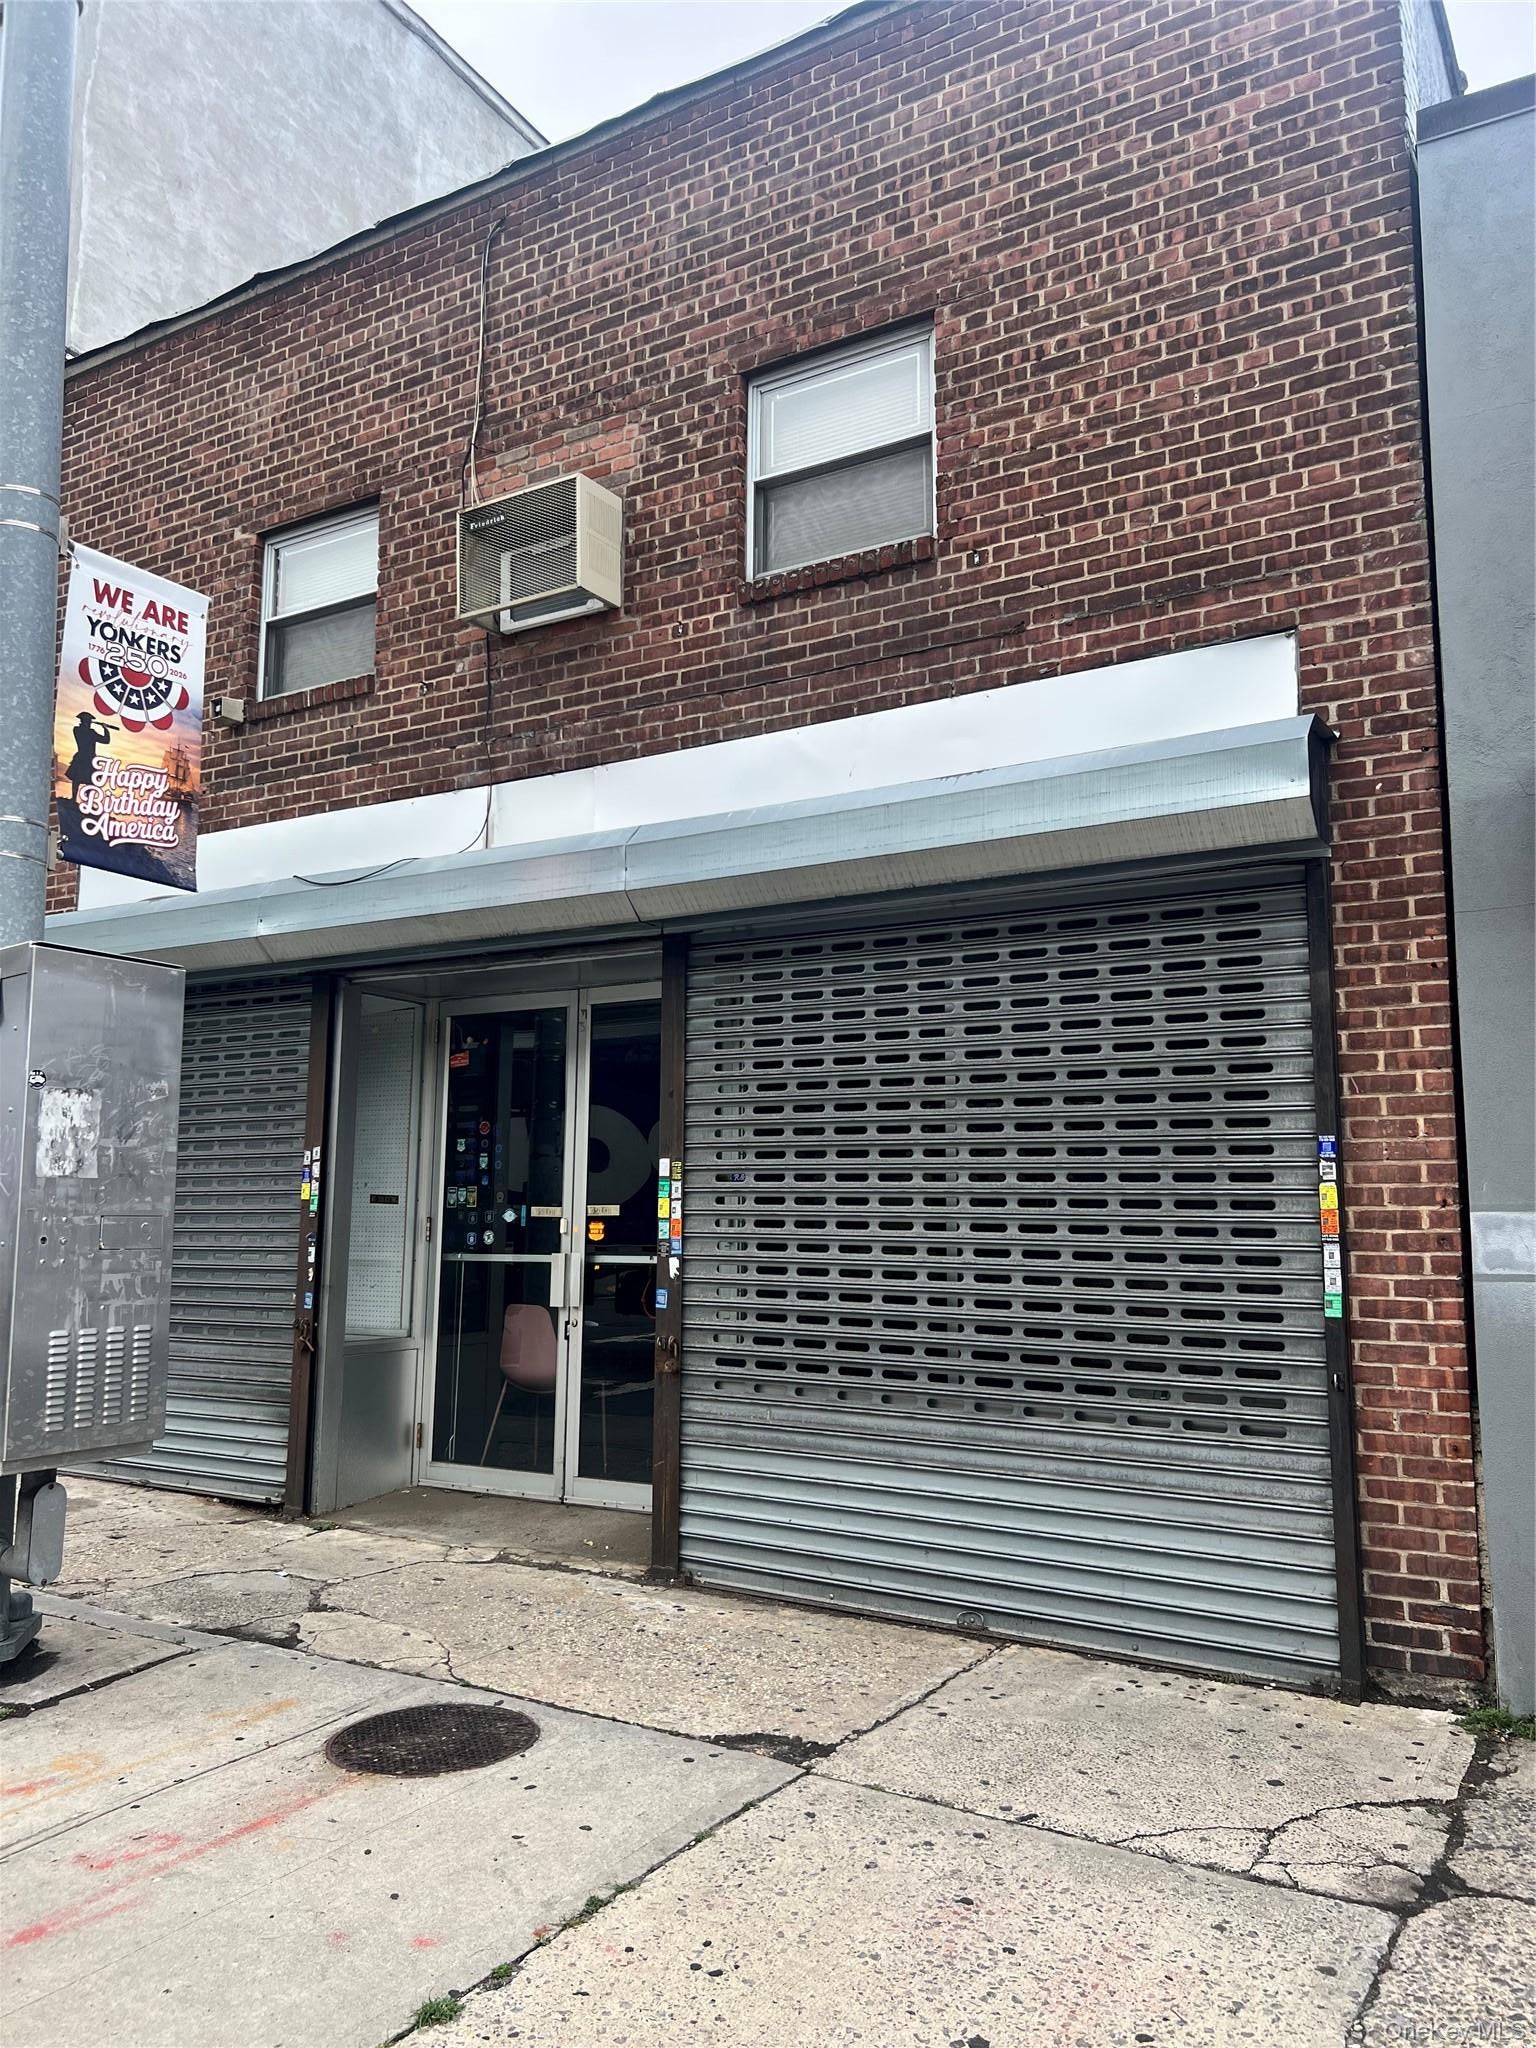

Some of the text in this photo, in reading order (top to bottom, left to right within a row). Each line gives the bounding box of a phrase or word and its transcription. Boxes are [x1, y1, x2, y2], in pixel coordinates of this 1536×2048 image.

[470, 514, 505, 530] Friedrich
[93, 578, 189, 635] WE ARE
[82, 604, 193, 658] revolutionary
[86, 615, 181, 664] YONKERS
[88, 642, 105, 655] 1776
[104, 640, 168, 679] 250
[169, 668, 187, 680] 2026
[91, 756, 169, 799] Happy
[79, 785, 180, 825] Birthday
[81, 813, 179, 847] America
